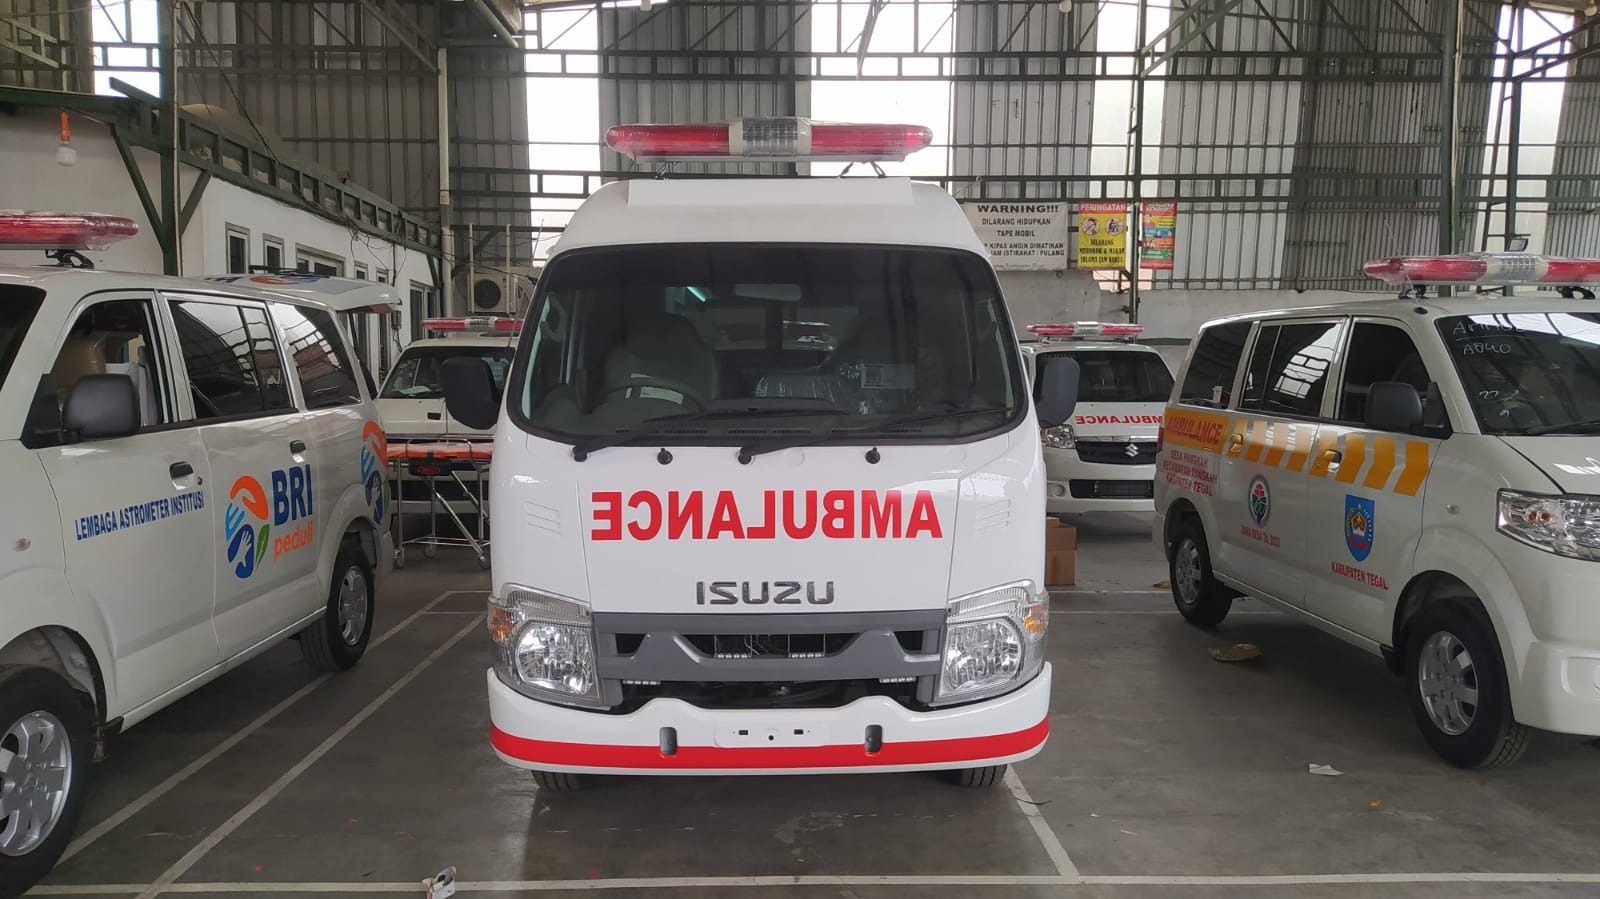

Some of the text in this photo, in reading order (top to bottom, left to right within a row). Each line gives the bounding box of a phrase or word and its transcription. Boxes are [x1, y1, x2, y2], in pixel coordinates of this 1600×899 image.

[976, 204, 1059, 213] WARNING!!!
[1080, 203, 1126, 211] PERINGATAN
[1166, 415, 1224, 445] AMBULANCE
[271, 463, 313, 526] BRI
[1193, 480, 1213, 496] TEGAL
[75, 490, 205, 540] LEMBAGA ASTROMETER INSTITUSI
[273, 519, 313, 564] peduli
[1331, 561, 1389, 590] KABUPATEN TEGAL
[695, 580, 835, 605] ISUZU
